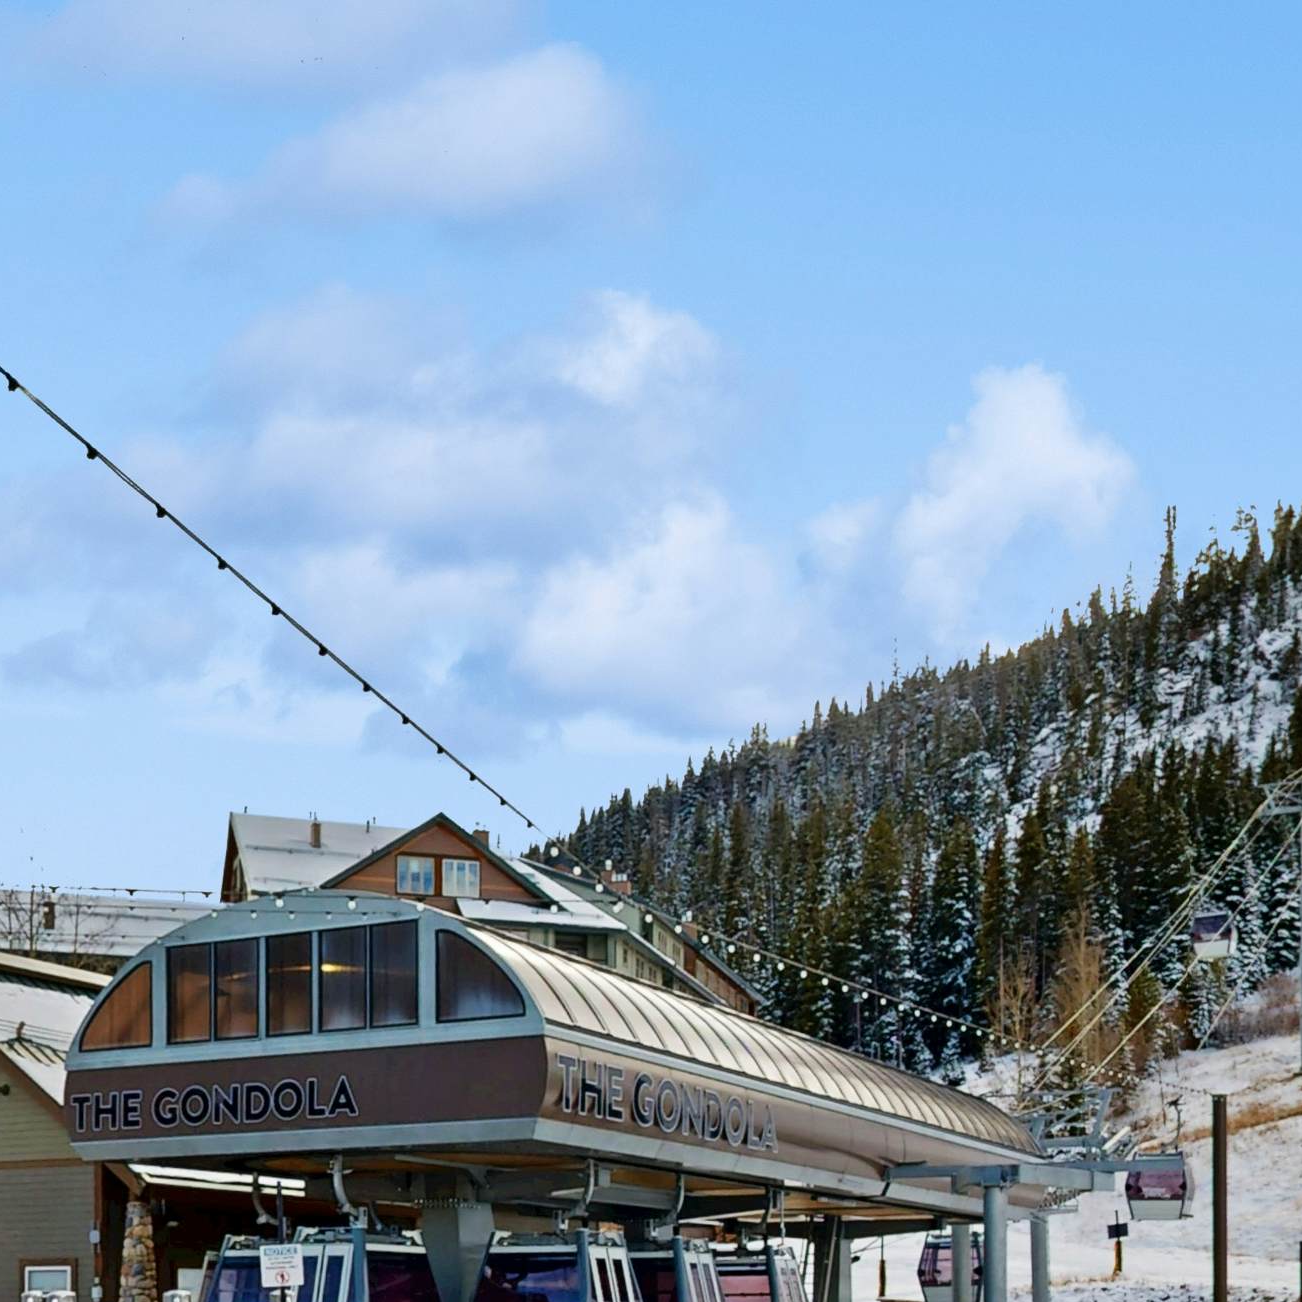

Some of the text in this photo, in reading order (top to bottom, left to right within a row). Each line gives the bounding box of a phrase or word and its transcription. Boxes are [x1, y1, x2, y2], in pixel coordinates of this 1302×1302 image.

[71, 1075, 358, 1132] THE GONDOLA
[557, 1052, 779, 1153] THE GONDOLA
